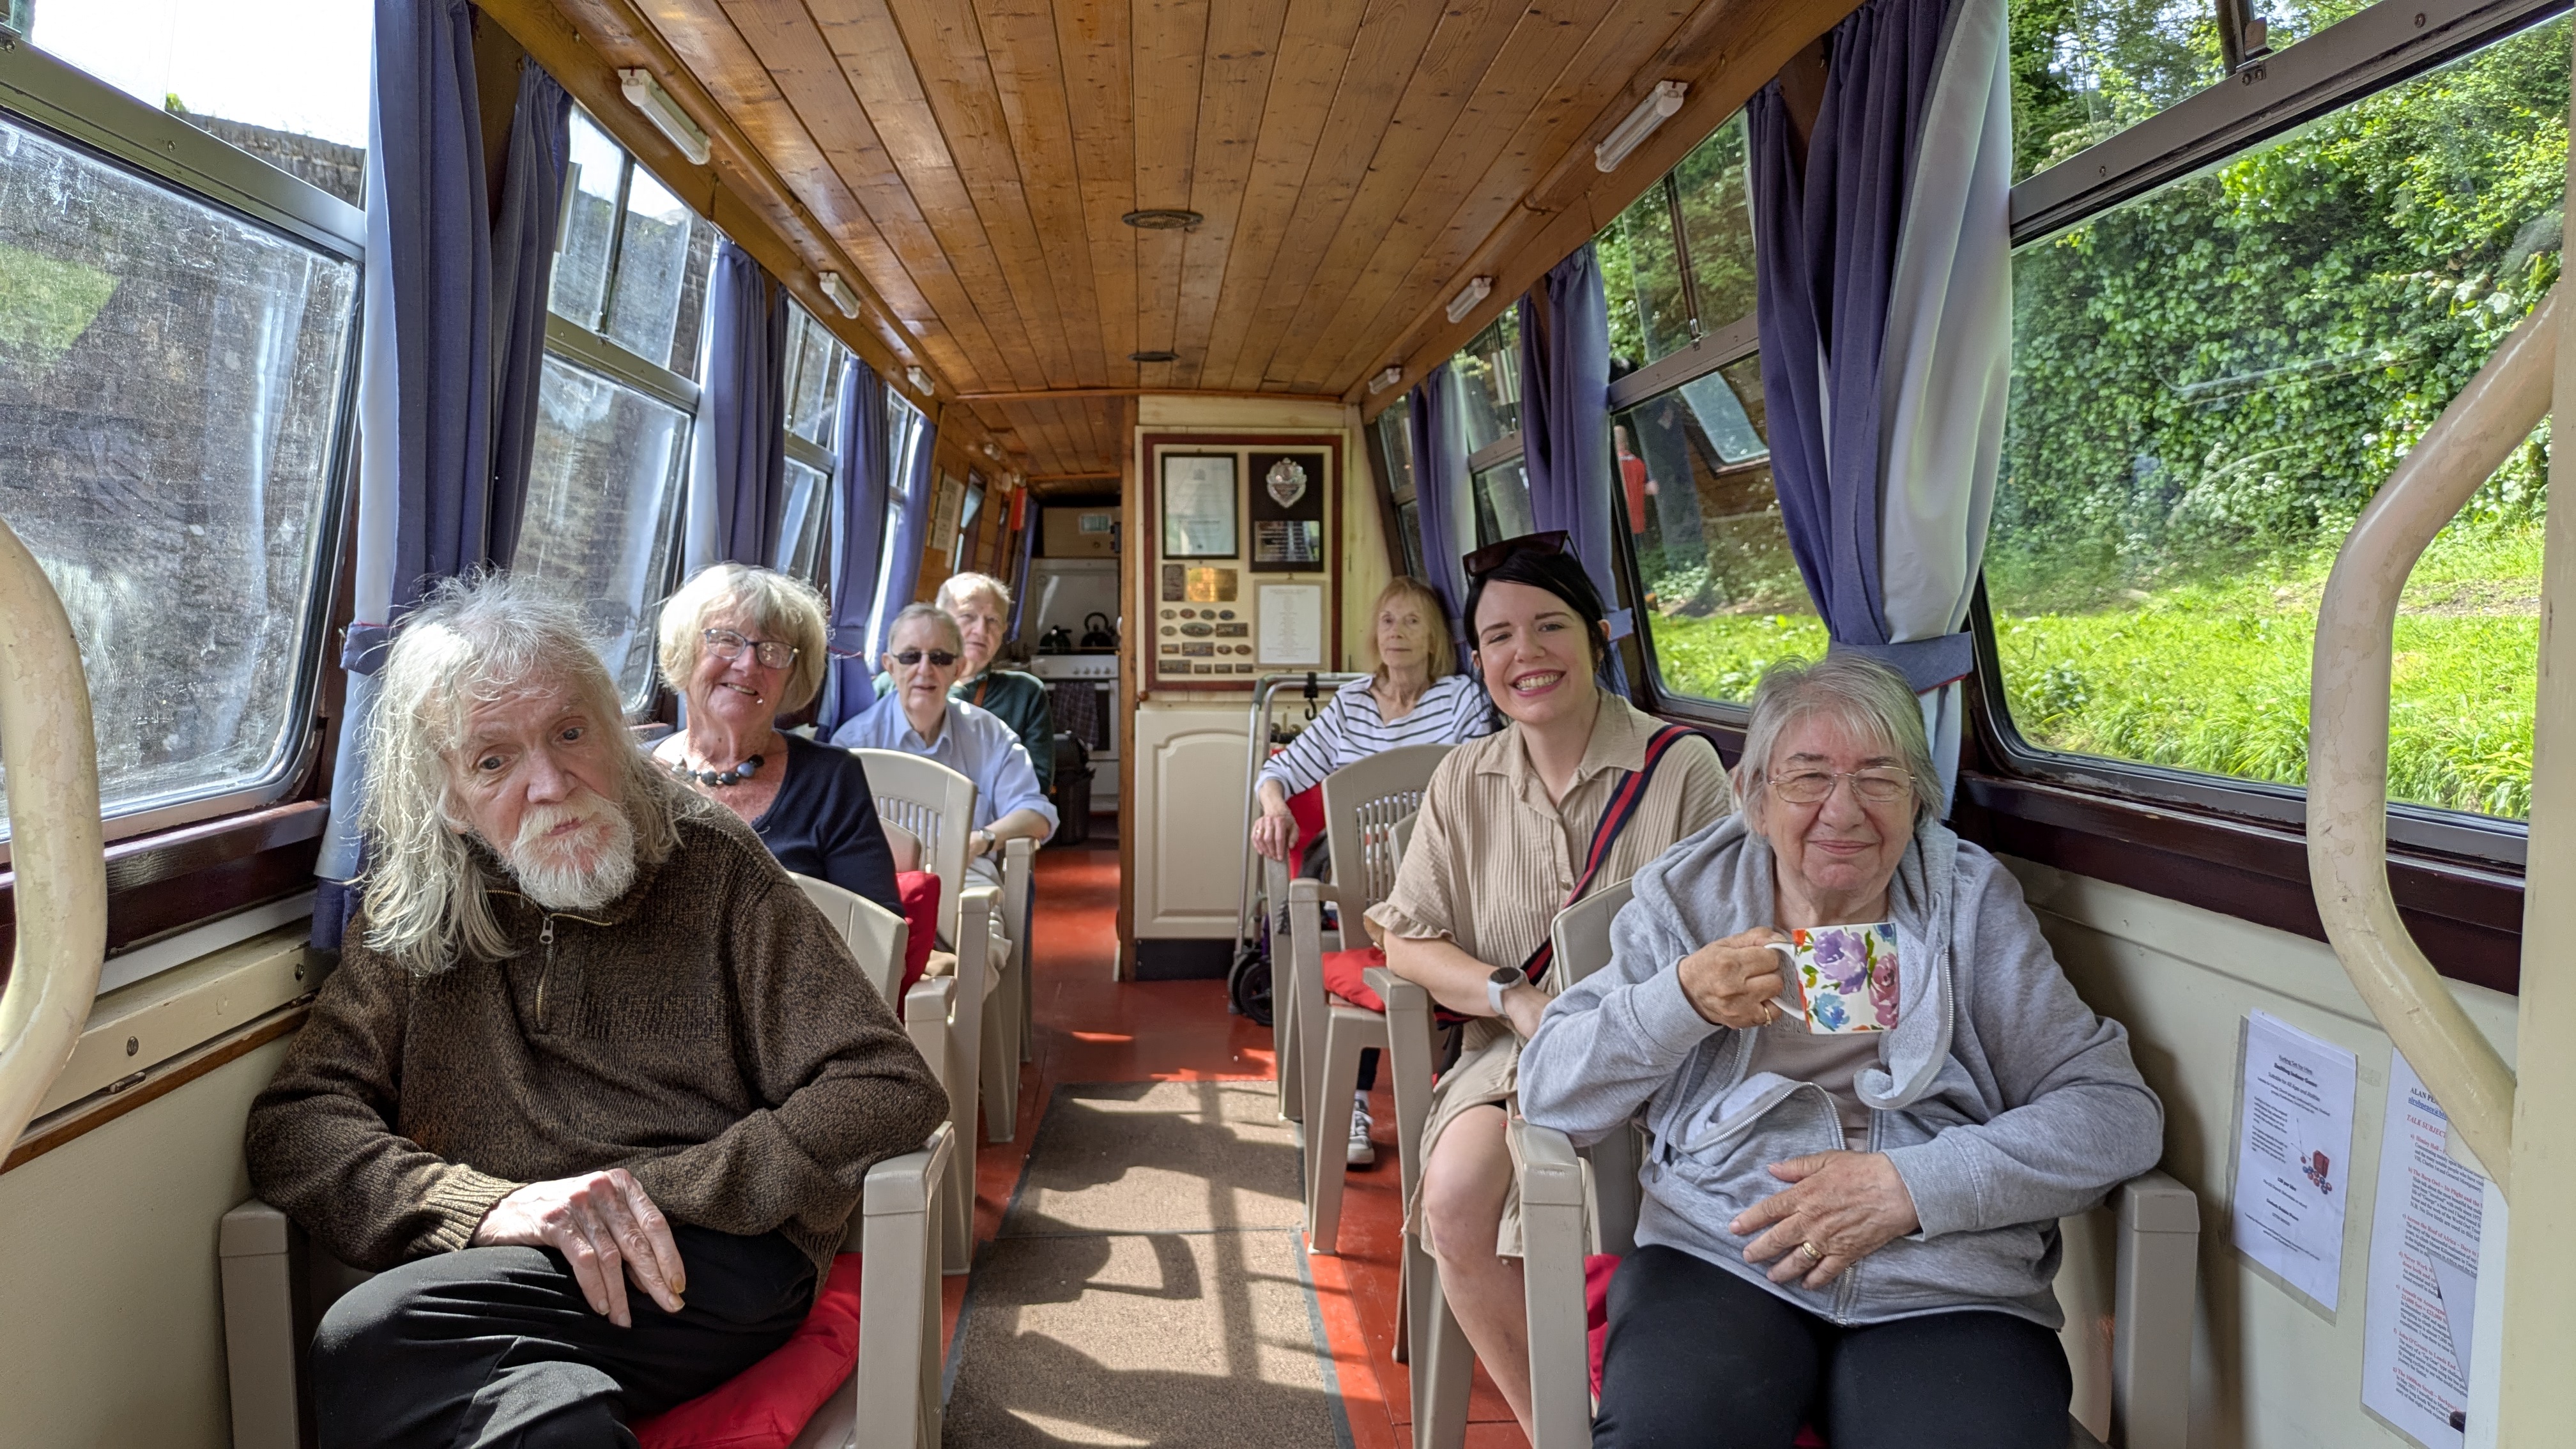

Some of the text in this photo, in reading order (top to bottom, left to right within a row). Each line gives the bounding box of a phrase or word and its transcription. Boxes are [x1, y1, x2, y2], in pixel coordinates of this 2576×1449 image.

[2410, 1087, 2437, 1105] ALAN PE
[2407, 1114, 2445, 1138] TALK SUBJECT
[2421, 1172, 2430, 1183] Barn
[2431, 1178, 2440, 1187] Owl
[2446, 1170, 2459, 1181] General
[2427, 1184, 2436, 1192] about
[2410, 1200, 2418, 1209] N.B.
[2434, 1213, 2443, 1223] birds
[2451, 1223, 2460, 1232] used
[2463, 1209, 2471, 1217] since
[2407, 1215, 2419, 1226] Across
[2427, 1225, 2437, 1235] Roof
[2443, 1234, 2456, 1245] Africa
[2460, 1243, 2471, 1254] Dare
[2402, 1260, 2412, 1269] done
[2412, 1265, 2421, 1275] both
[2404, 1252, 2415, 1264] Never
[2416, 1260, 2428, 1271] Work
[2405, 1302, 2421, 1316] December
[2407, 1317, 2422, 1329] mountain
[2428, 1336, 2437, 1345] there
[2399, 1330, 2408, 1341] John
[2447, 1360, 2456, 1370] End
[2402, 1353, 2412, 1363] young
[2443, 1379, 2453, 1388] could
[2395, 1387, 2404, 1396] story
[2423, 1406, 2432, 1414] week
[2416, 1394, 2426, 1404] South
[2426, 1400, 2435, 1411] West
